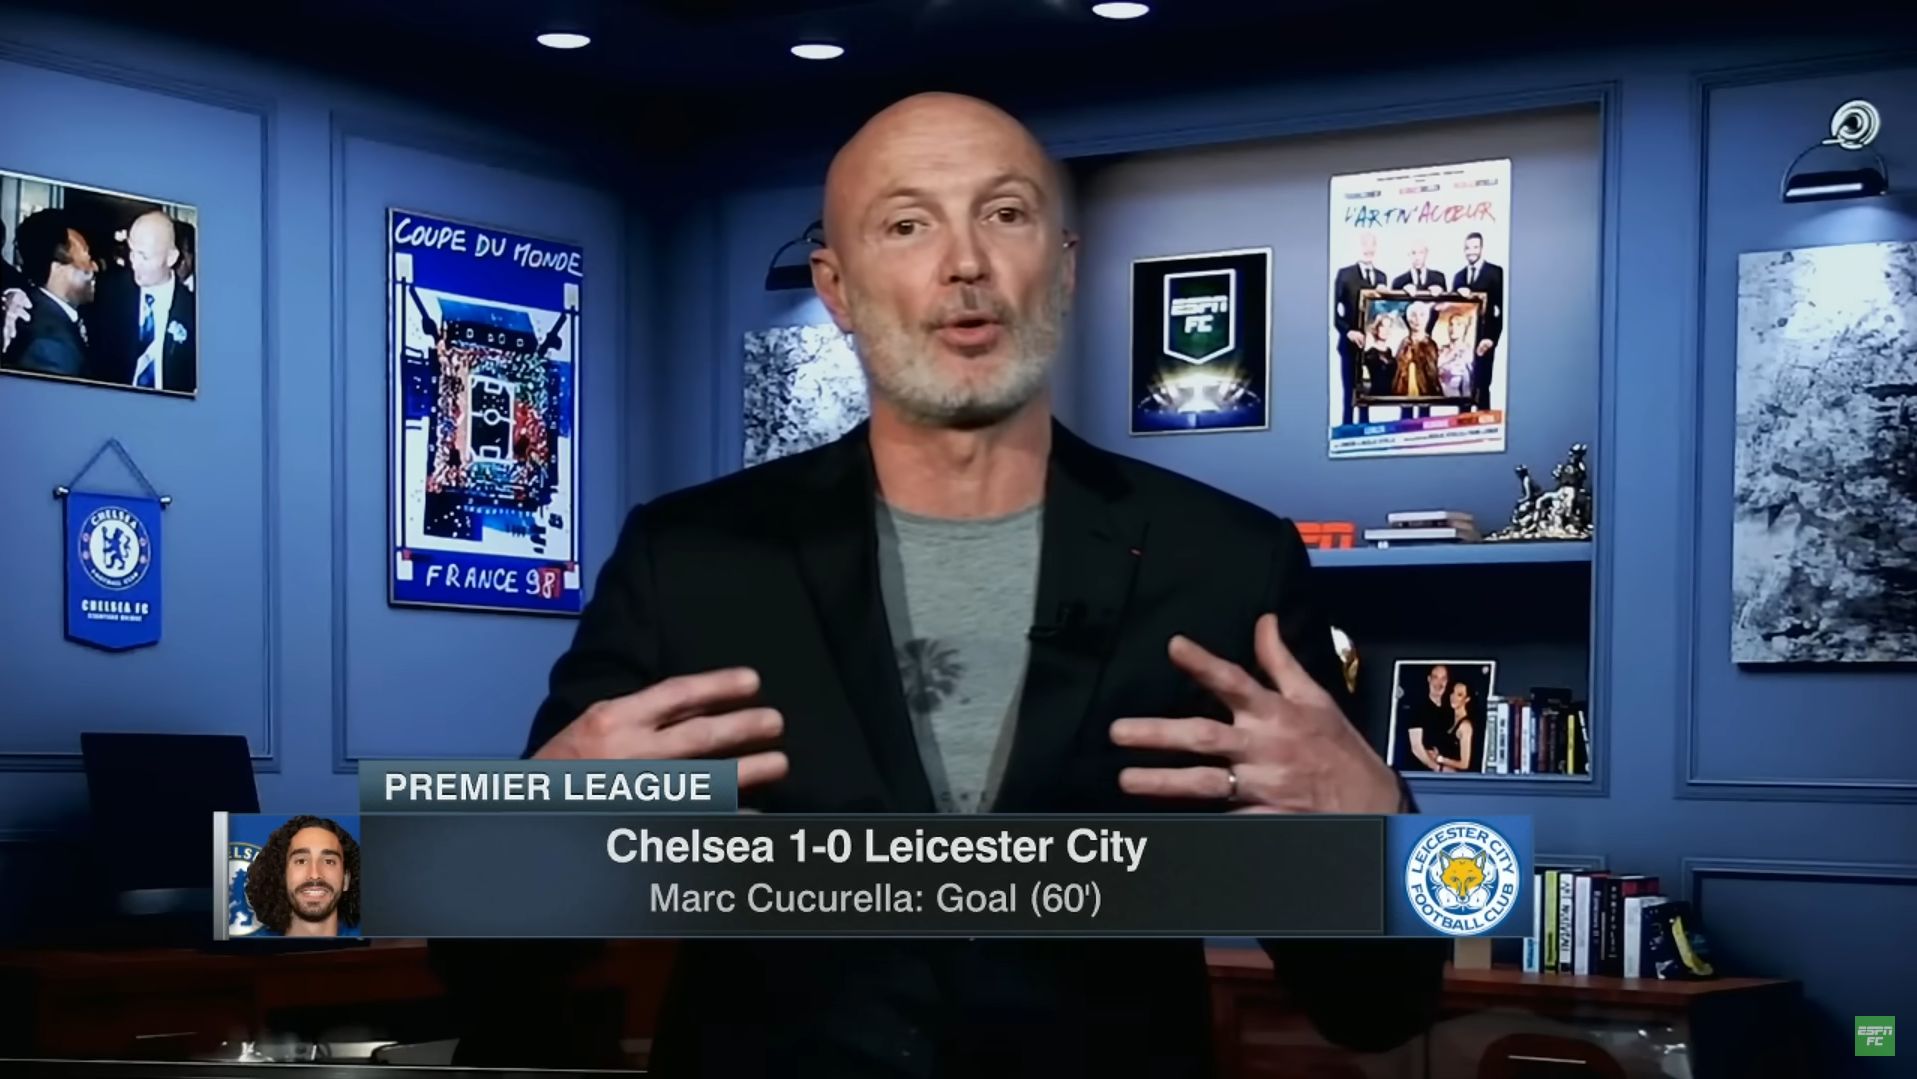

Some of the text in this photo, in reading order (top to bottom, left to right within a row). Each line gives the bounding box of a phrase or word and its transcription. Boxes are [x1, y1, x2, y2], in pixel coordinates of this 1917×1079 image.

[395, 217, 584, 277] COUPE DU MONDE
[1171, 295, 1228, 316] ESPN
[1184, 314, 1214, 333] FC
[90, 508, 139, 530] CHELSEA
[426, 563, 556, 599] FRANCE 98
[81, 599, 132, 613] CHELSEA
